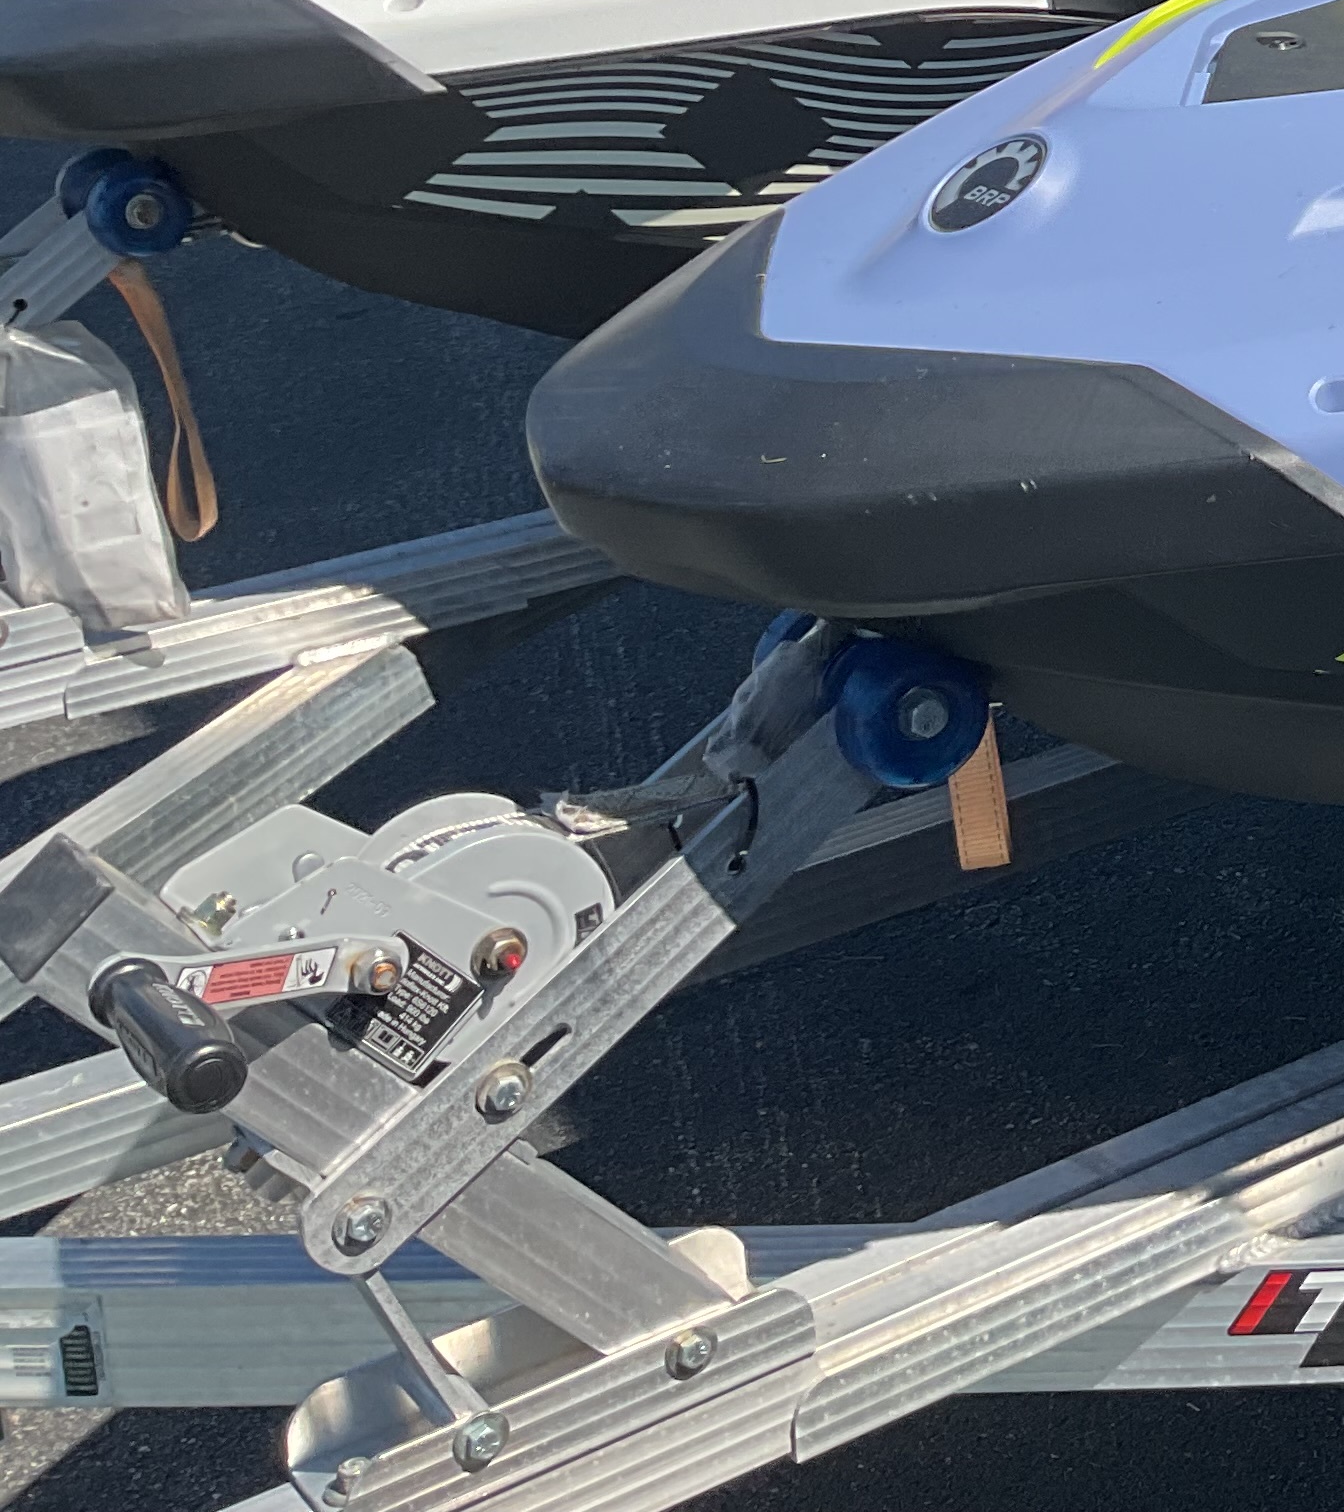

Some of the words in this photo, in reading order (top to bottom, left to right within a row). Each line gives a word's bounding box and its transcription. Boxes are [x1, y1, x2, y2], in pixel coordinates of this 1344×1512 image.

[964, 185, 1011, 207] BRP
[417, 952, 453, 981] KNOTT
[376, 1009, 392, 1023] ade
